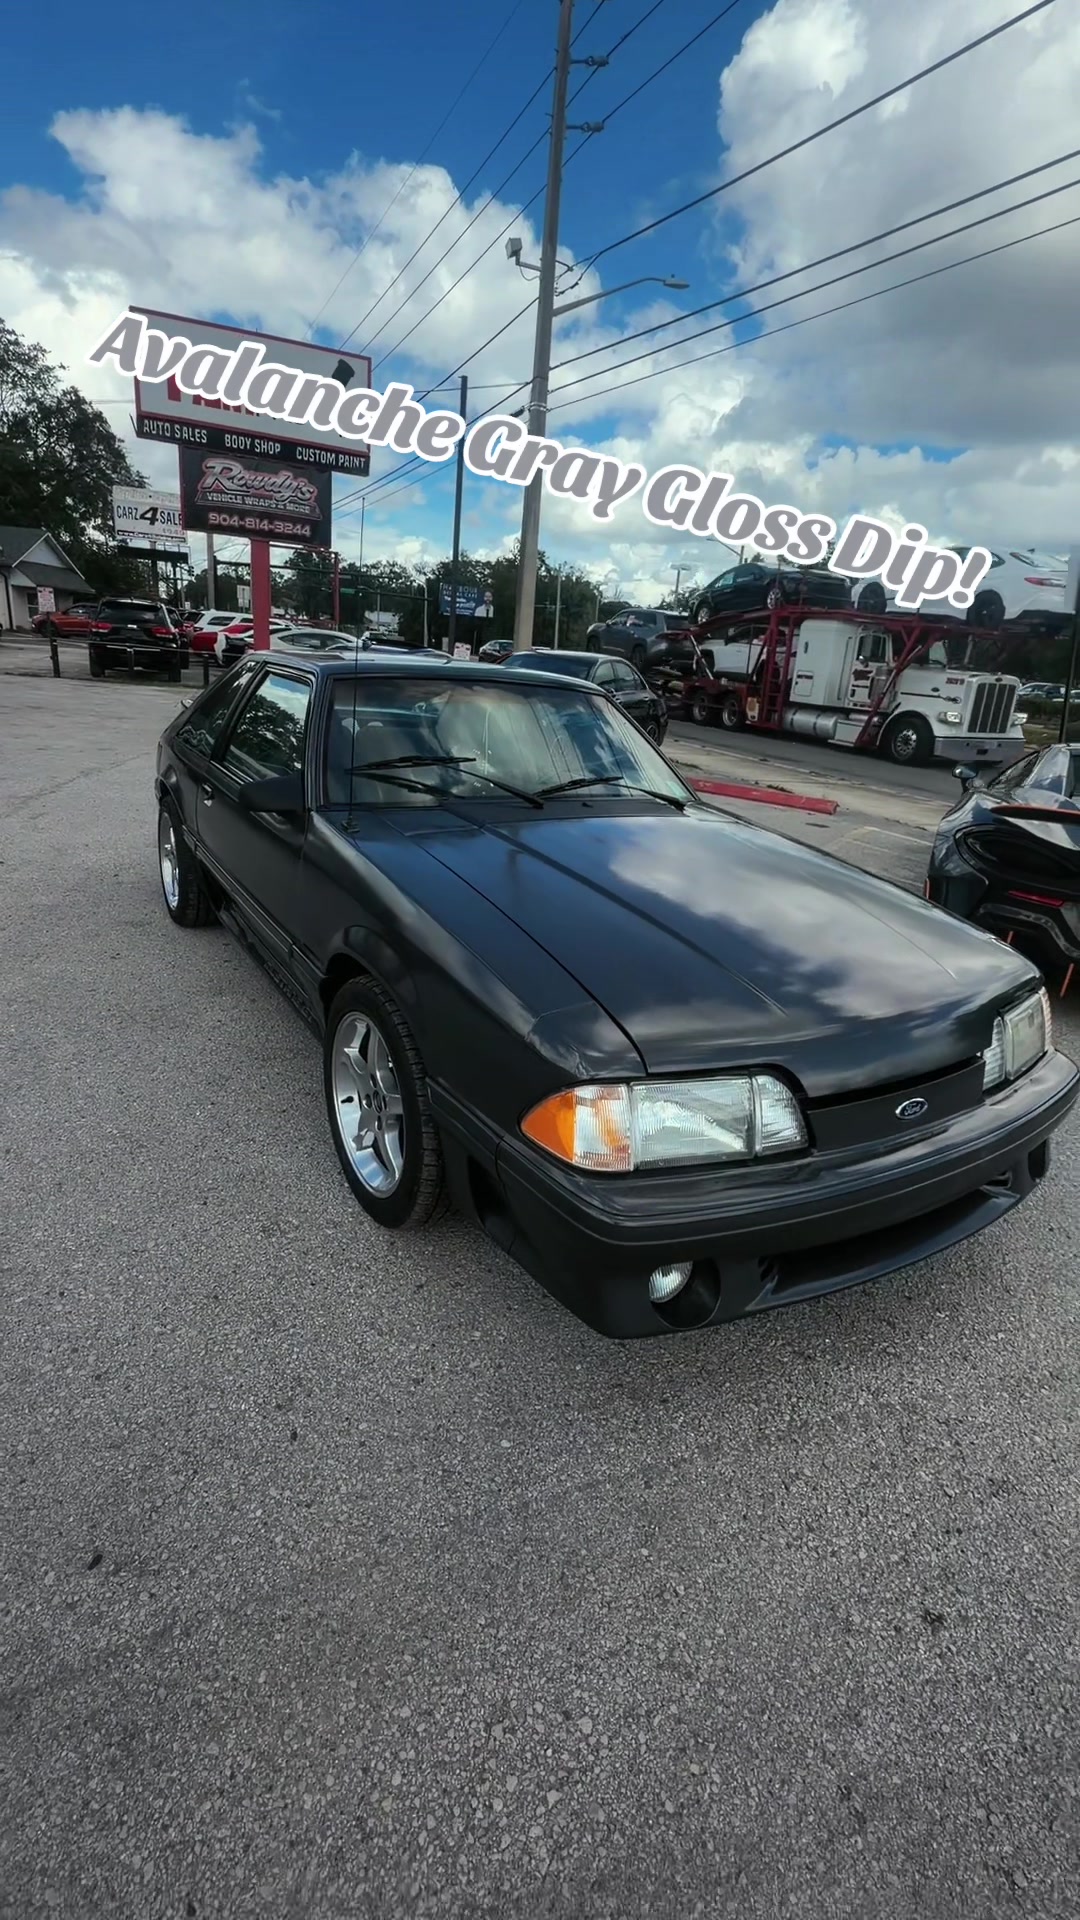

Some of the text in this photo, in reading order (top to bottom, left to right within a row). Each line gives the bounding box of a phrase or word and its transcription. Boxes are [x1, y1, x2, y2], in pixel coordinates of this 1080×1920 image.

[143, 419, 208, 443] AUTO SALES
[224, 433, 281, 455] BODY SHOP
[296, 446, 366, 469] CUSTOM PAINT
[201, 459, 315, 503] Rowdy's
[206, 492, 243, 504] VEHICLE
[244, 496, 276, 508] WRAPS
[286, 502, 311, 514] MORE
[116, 505, 139, 520] CARZ
[139, 506, 159, 526] 4
[208, 512, 311, 537] 904-814-3244
